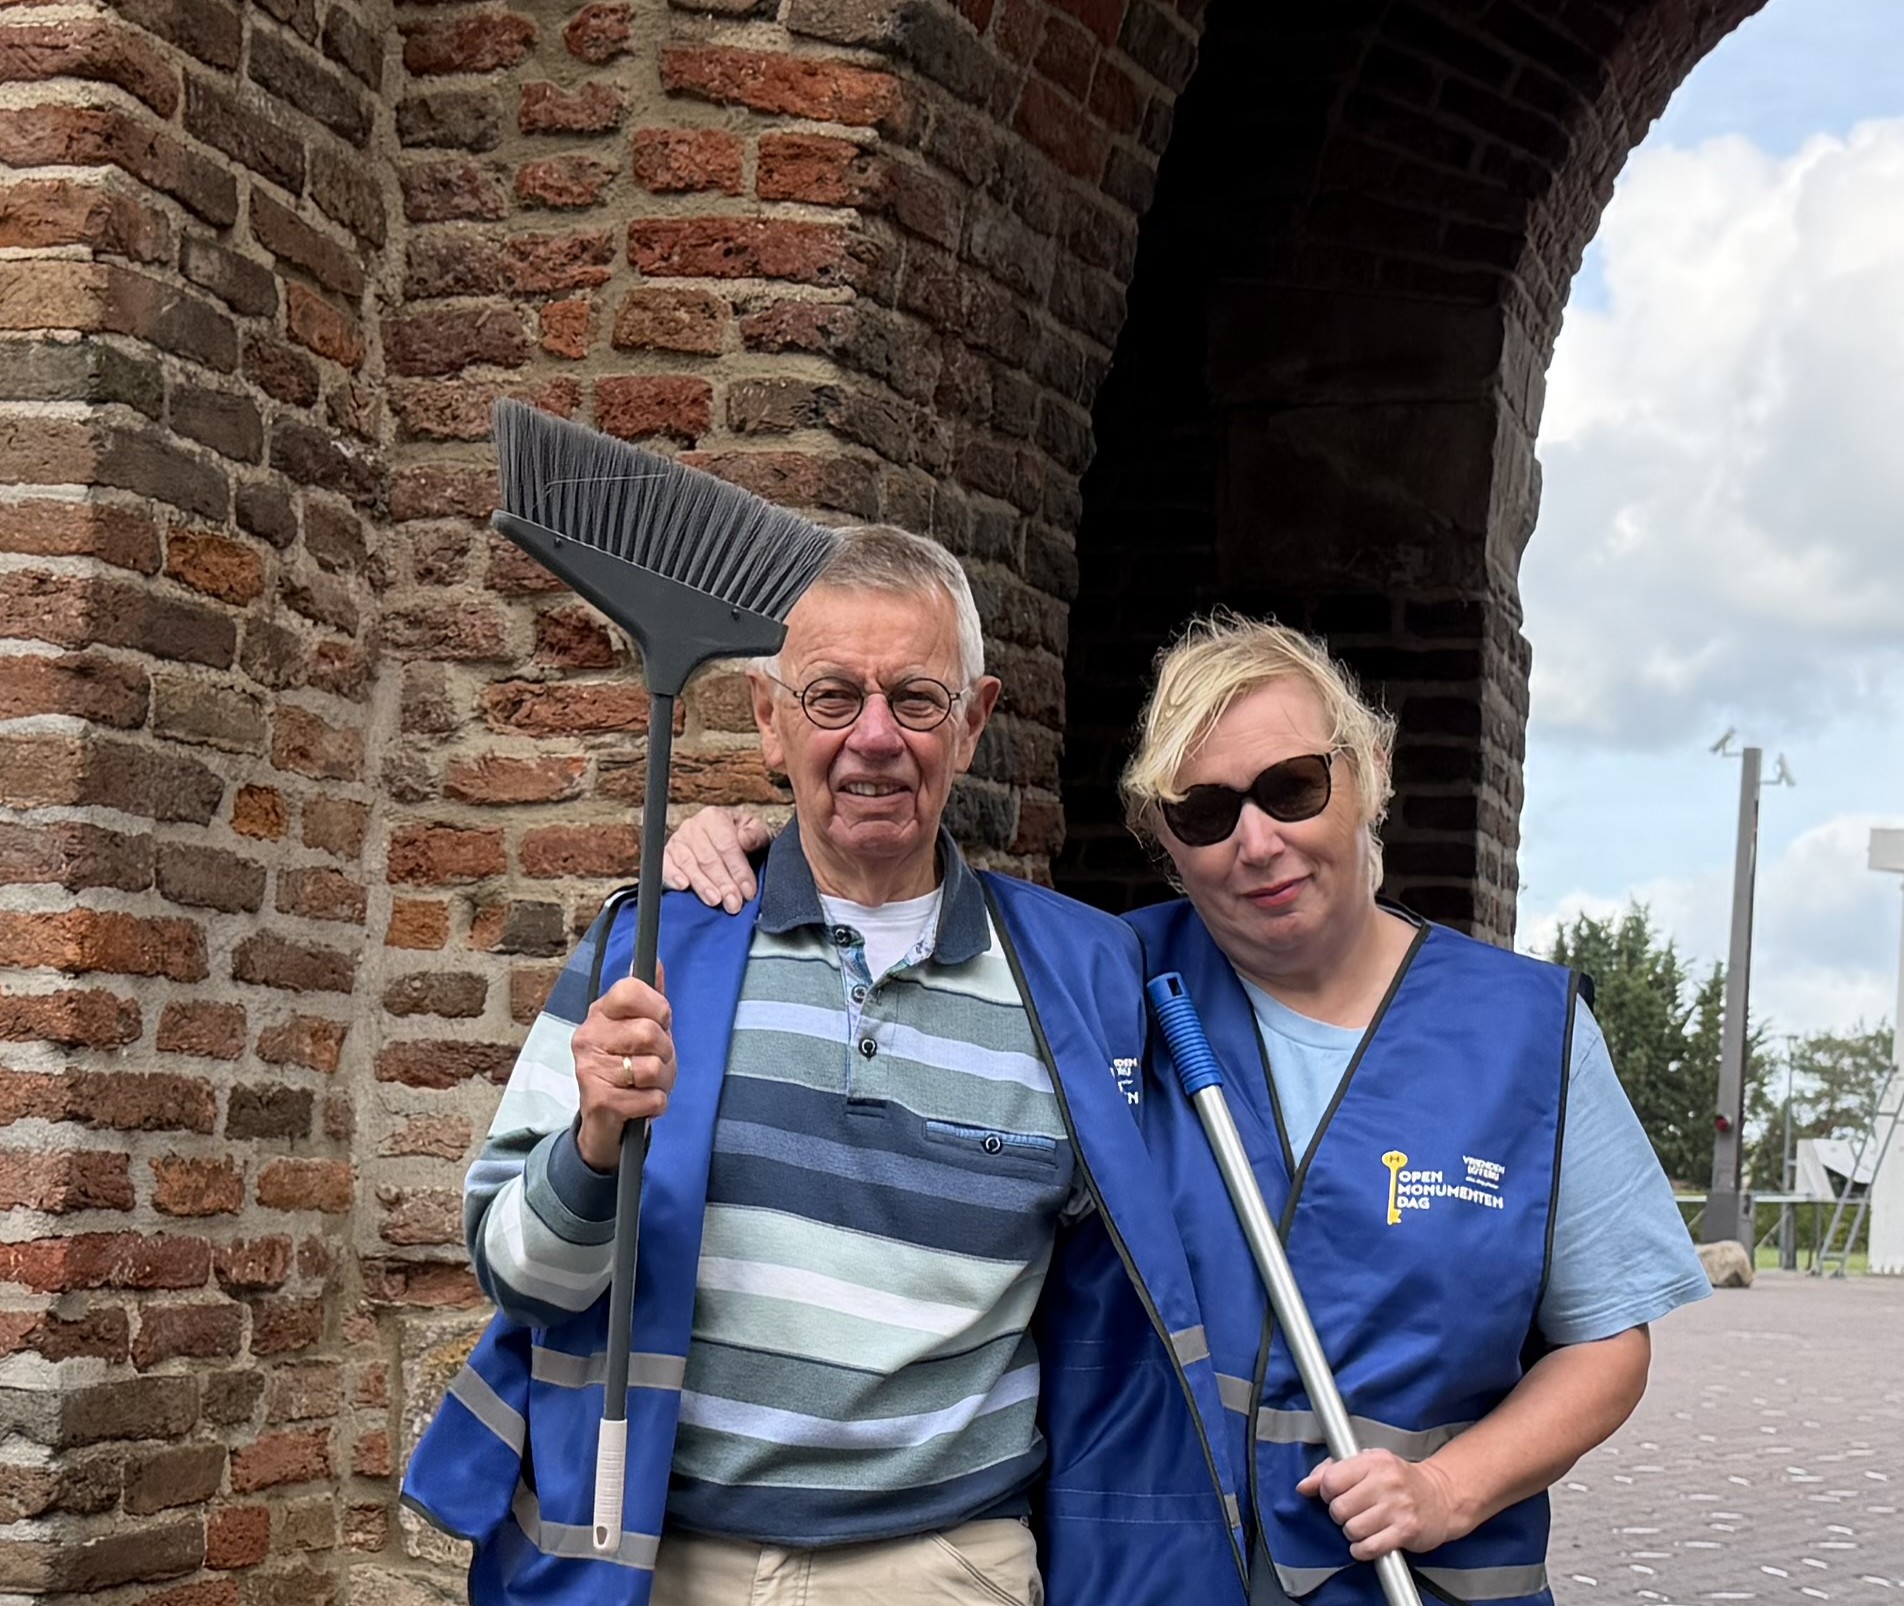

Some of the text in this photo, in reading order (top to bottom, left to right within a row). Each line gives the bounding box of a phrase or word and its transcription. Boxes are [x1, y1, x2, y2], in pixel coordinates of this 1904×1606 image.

[1398, 1170, 1443, 1183] OPEN
[1396, 1196, 1431, 1209] DAG
[1397, 1183, 1504, 1209] MONUMENTEN
